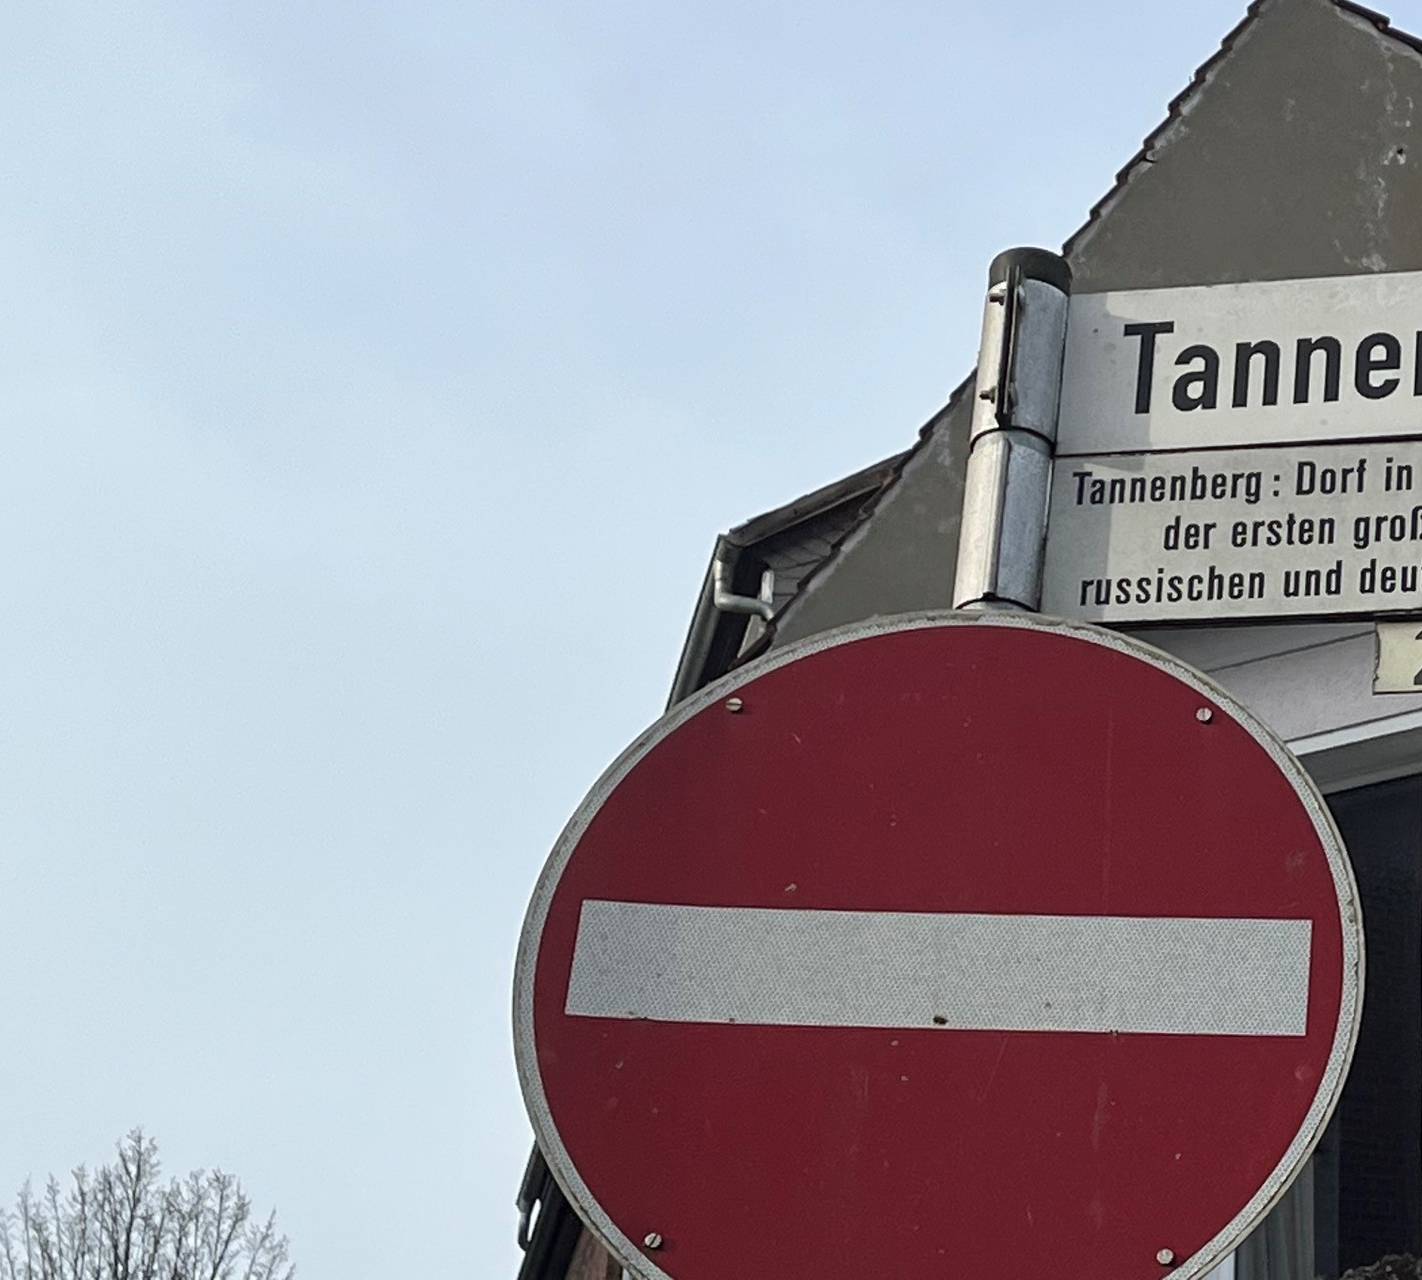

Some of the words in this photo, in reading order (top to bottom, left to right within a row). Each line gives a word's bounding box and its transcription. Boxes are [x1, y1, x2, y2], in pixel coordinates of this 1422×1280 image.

[1296, 459, 1366, 495] Dorf
[1385, 457, 1412, 491] in
[1164, 516, 1216, 550] der
[1232, 513, 1334, 547] ersten
[1081, 566, 1264, 605] russischen
[1284, 560, 1342, 597] und
